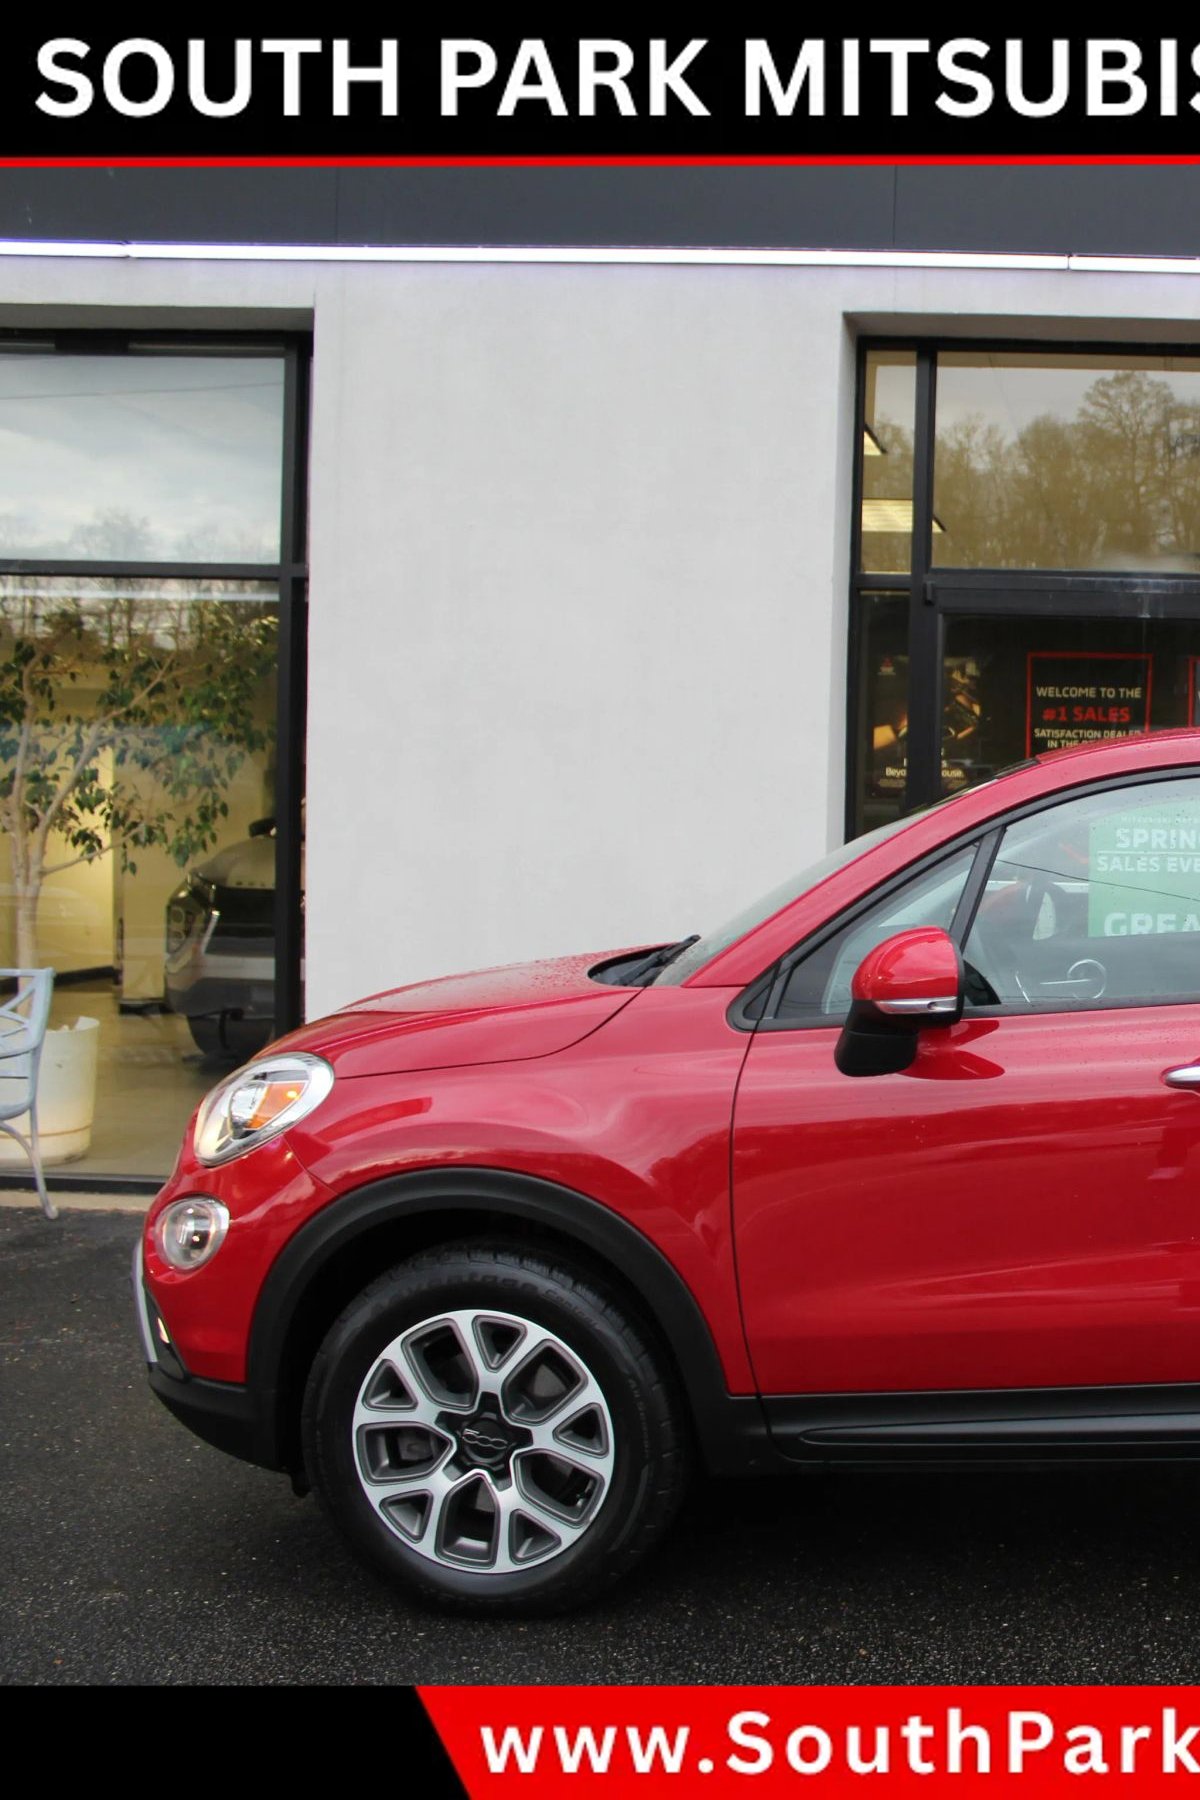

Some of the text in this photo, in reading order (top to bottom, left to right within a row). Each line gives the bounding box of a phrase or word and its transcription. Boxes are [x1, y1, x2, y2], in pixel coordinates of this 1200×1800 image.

[1036, 686, 1142, 699] WELCOME TO THE
[1072, 706, 1131, 722] SALES
[1033, 727, 1100, 739] SATISFACTION
[1047, 740, 1058, 748] IN
[1096, 856, 1161, 872] SALES
